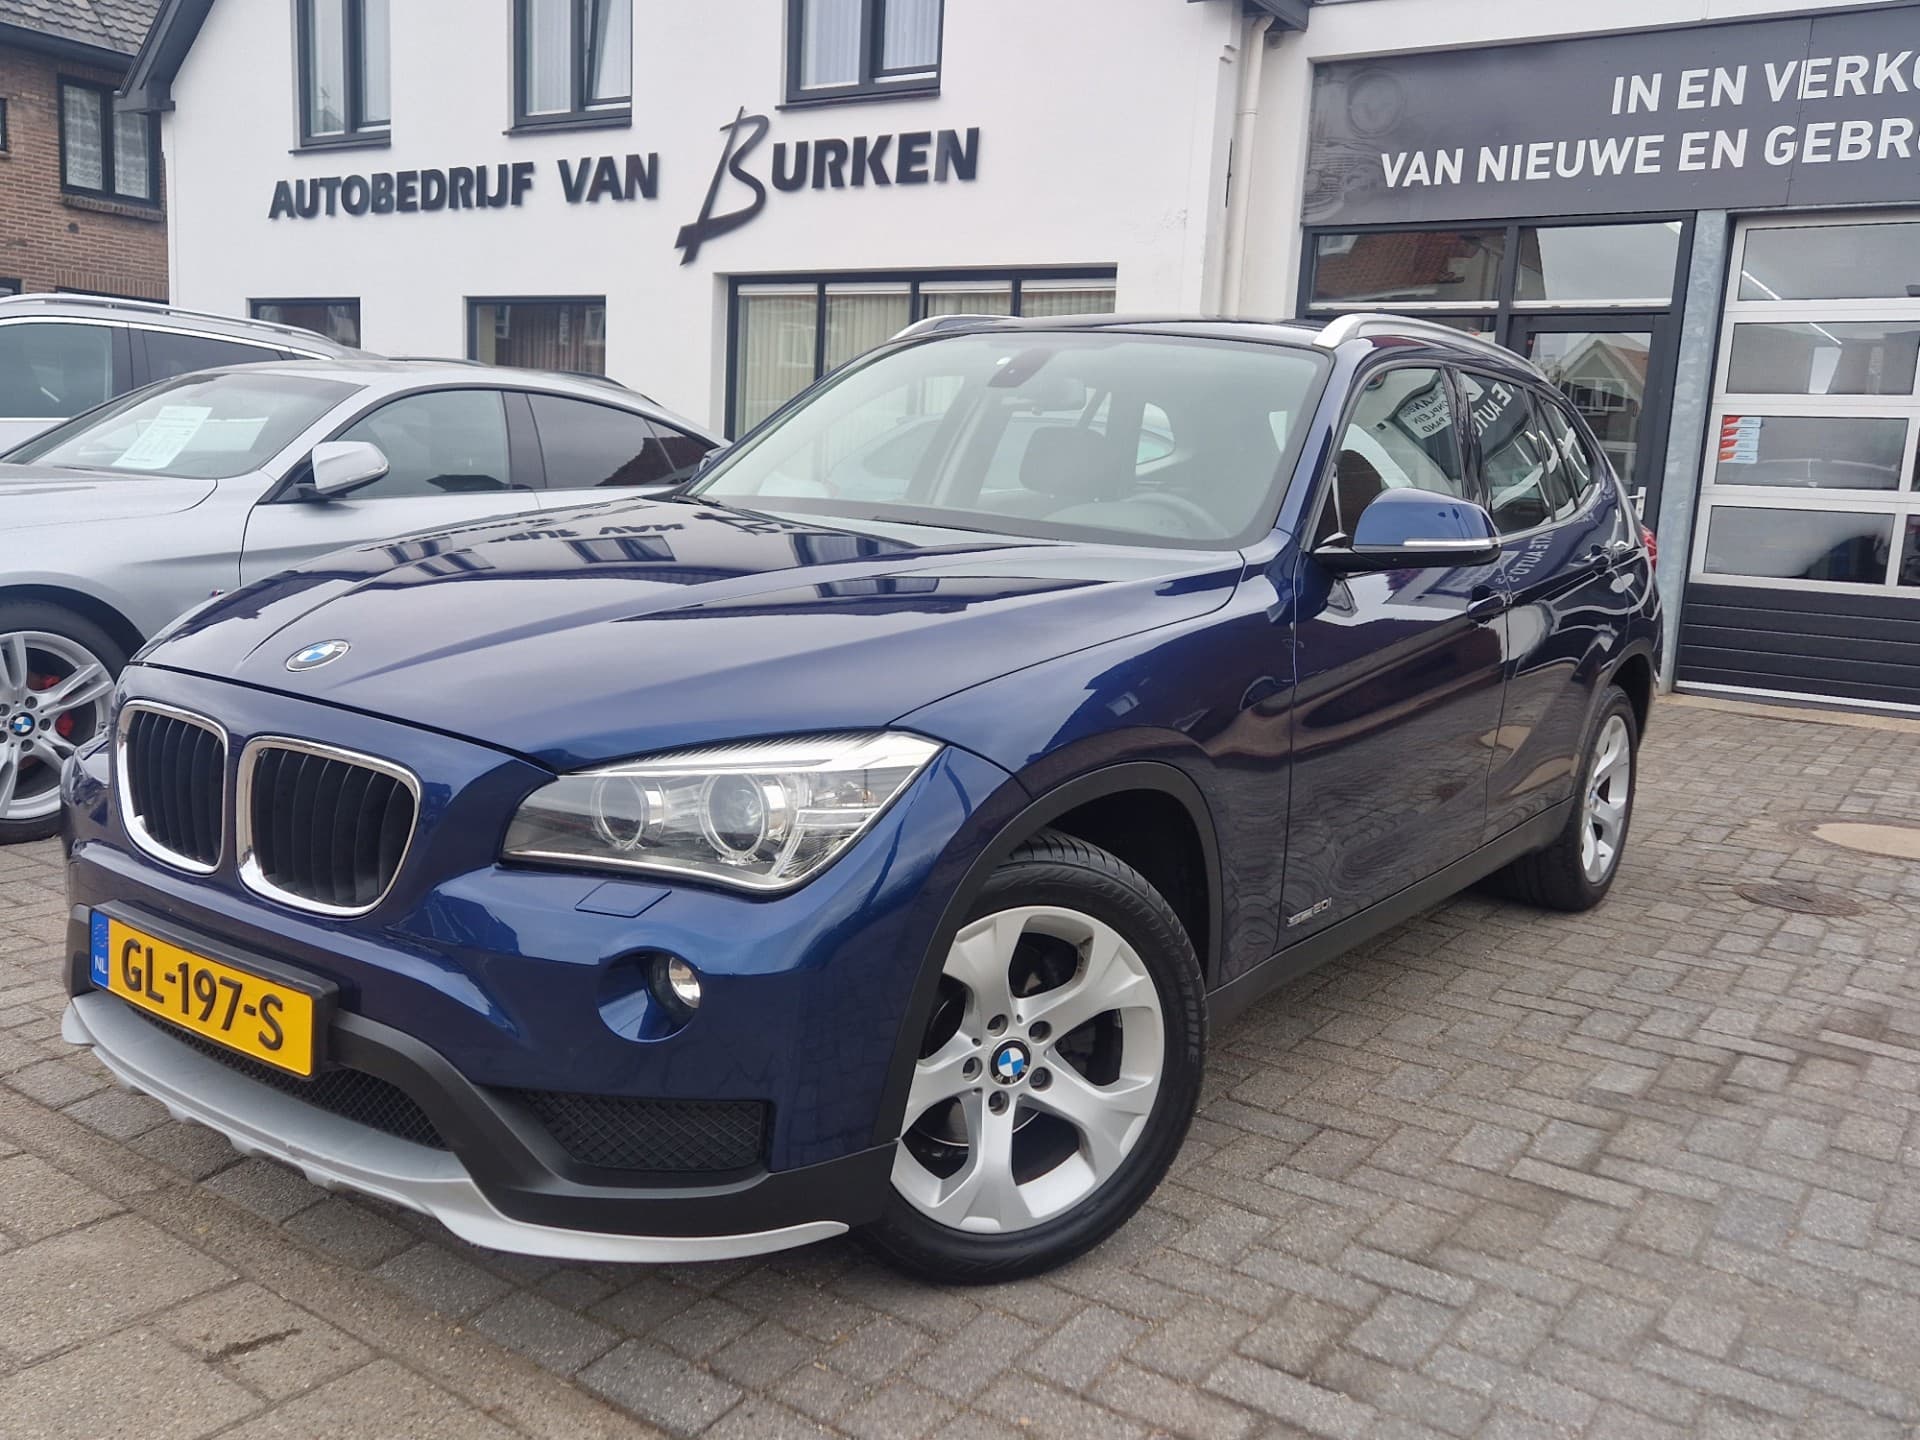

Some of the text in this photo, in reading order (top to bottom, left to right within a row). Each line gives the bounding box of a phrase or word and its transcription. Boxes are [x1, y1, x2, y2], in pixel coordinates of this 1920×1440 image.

[1611, 50, 1920, 115] IN EN VERK
[268, 106, 980, 266] AUTOBEDRIJF VAN BURKEN
[1381, 117, 1920, 188] VAN NIEUWE EN GEBR
[94, 955, 107, 974] NL
[121, 937, 284, 1051] GL-197-S
